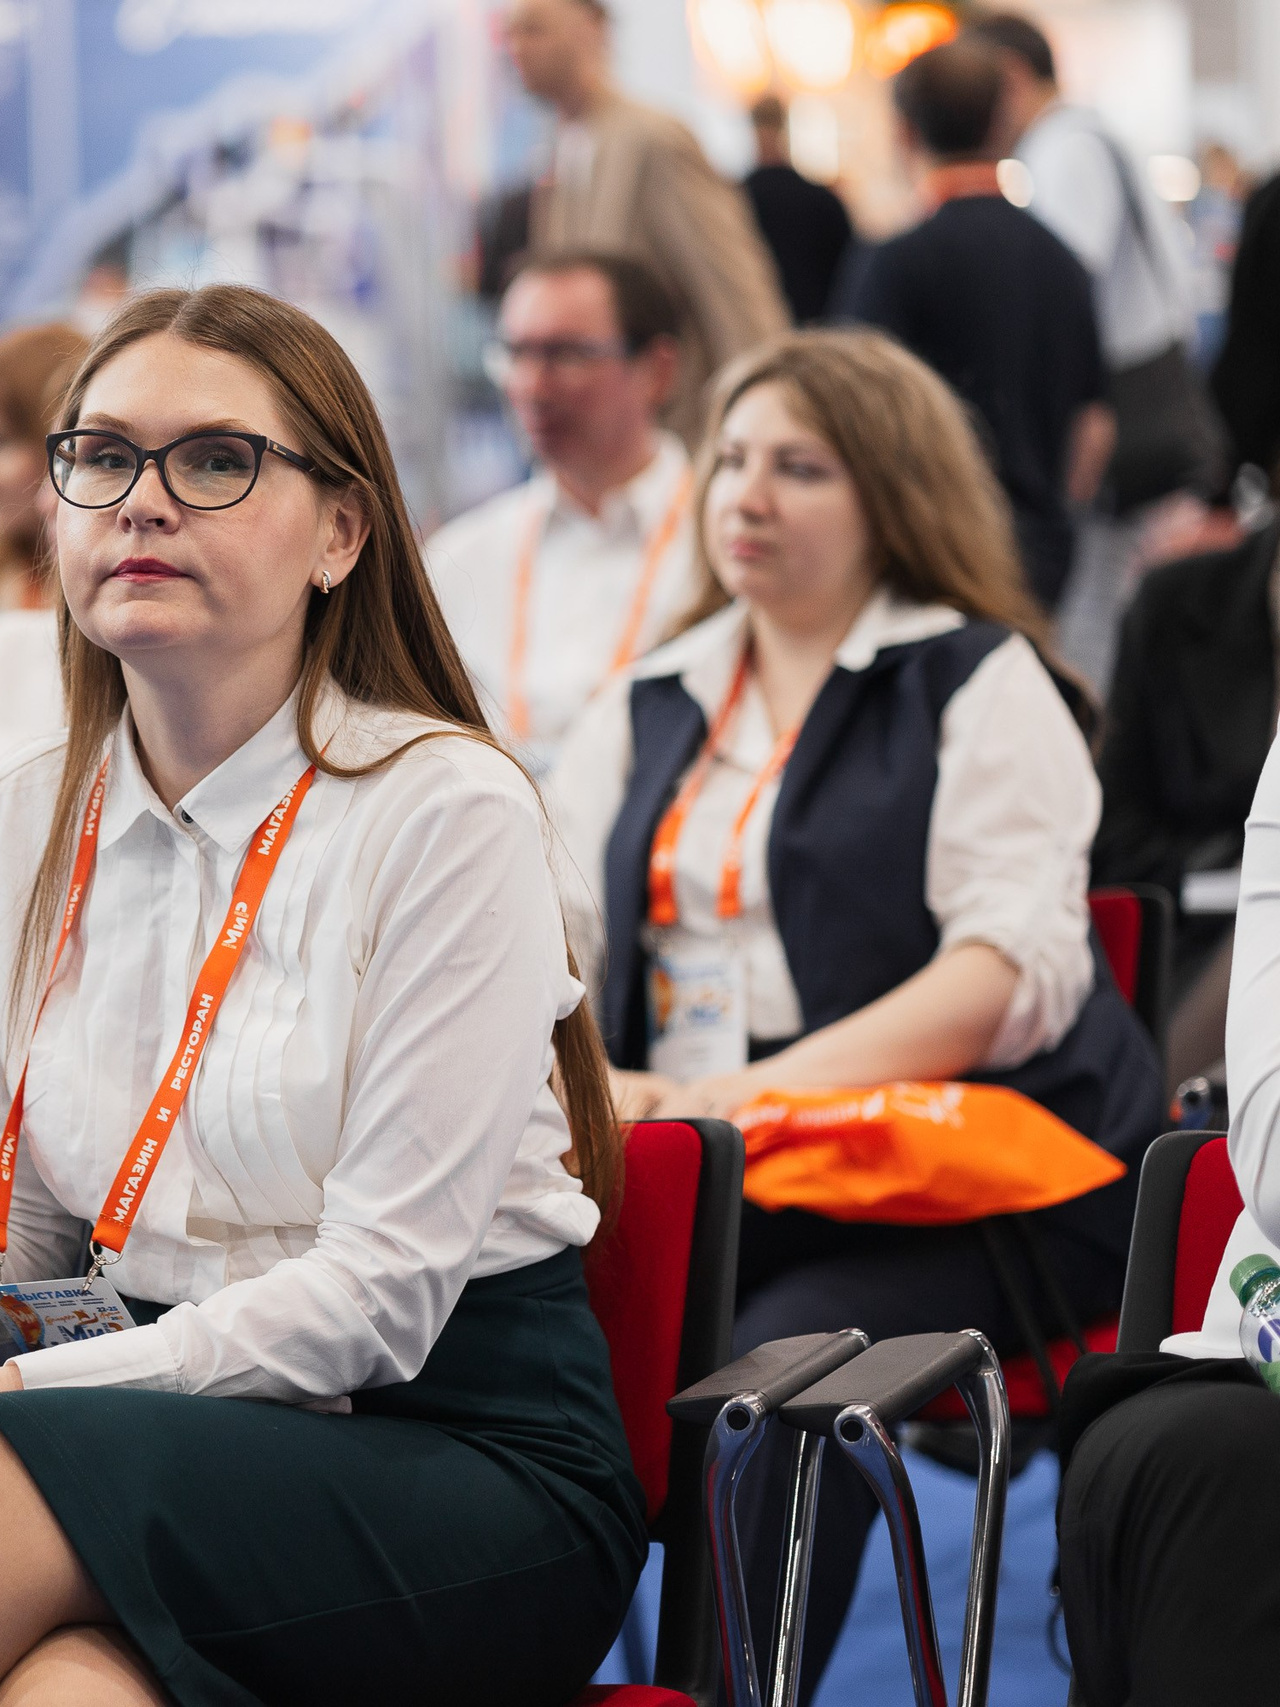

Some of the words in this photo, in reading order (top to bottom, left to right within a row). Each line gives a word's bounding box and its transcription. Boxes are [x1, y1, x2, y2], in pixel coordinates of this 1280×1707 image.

[112, 1137, 158, 1223] МАГАЗИН
[156, 1106, 171, 1122] И
[170, 993, 214, 1091] РЕСТОРАН
[257, 782, 300, 856] МАГАЗ
[14, 1288, 95, 1301] ВЫСТАВКА
